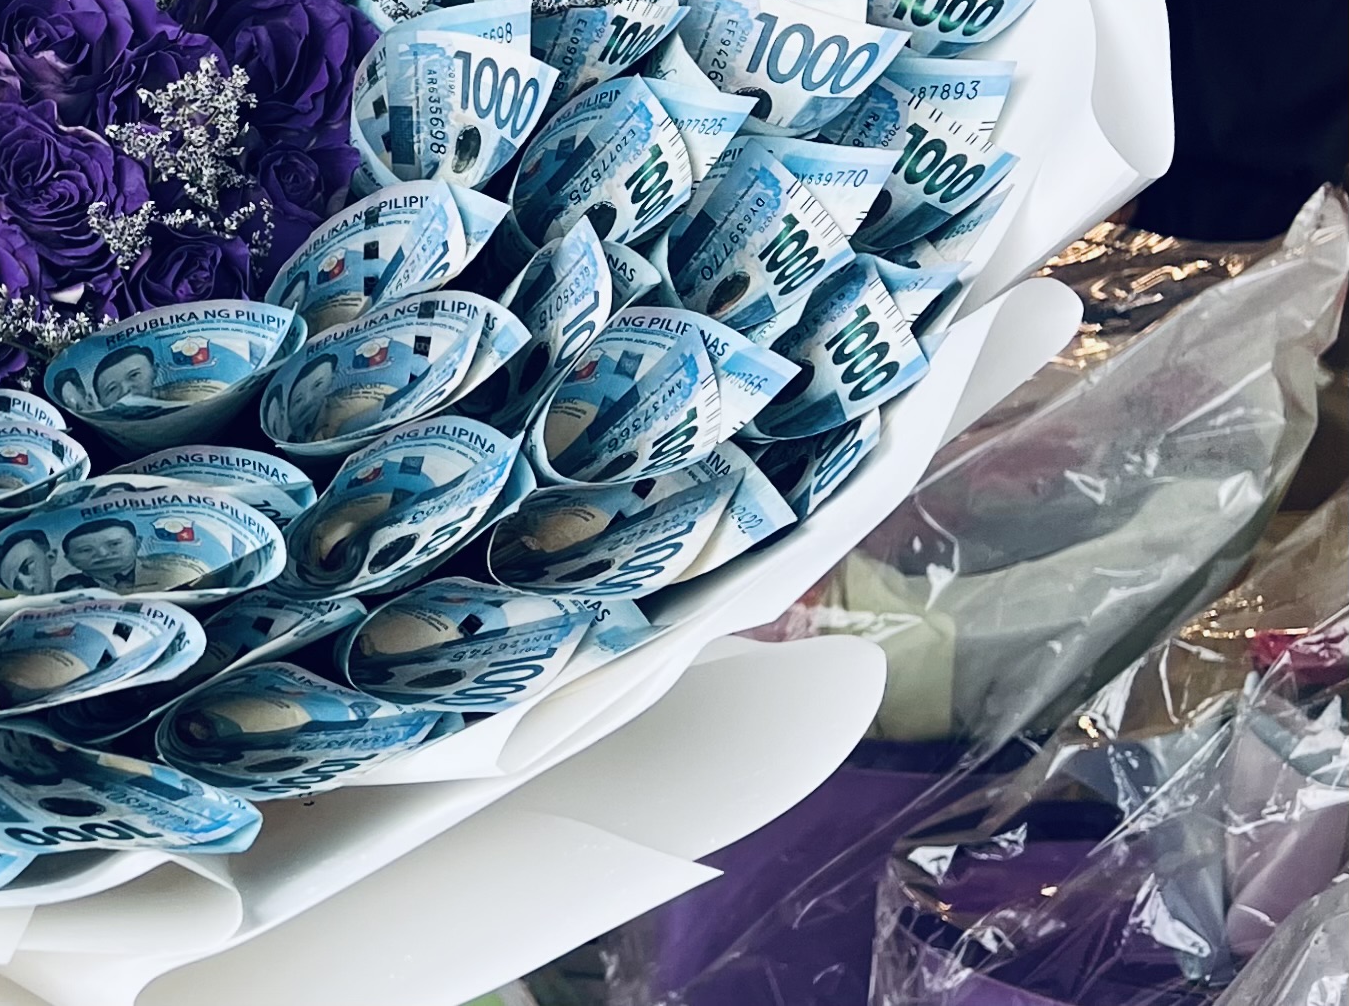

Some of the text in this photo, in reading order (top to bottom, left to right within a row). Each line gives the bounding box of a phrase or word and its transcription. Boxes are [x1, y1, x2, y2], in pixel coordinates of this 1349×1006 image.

[598, 14, 666, 65] 1000
[746, 11, 881, 96] 1000
[427, 69, 447, 155] AR635698
[454, 50, 539, 139] 1000
[624, 144, 674, 232] 1000
[892, 122, 986, 204] 1000
[757, 213, 825, 296] 1000
[106, 312, 199, 345] REPUBLIKA
[203, 309, 230, 320] NG
[306, 314, 390, 357] REPUBLIKA
[393, 302, 419, 319] NG
[617, 316, 644, 328] NG
[824, 304, 900, 403] 1000
[176, 454, 289, 485] NG PILIPINAS
[80, 494, 182, 518] REPUBLIKA
[188, 495, 215, 507] NG
[592, 517, 695, 595] 1000
[436, 647, 558, 708] 1000
[4, 820, 163, 847] 1000
